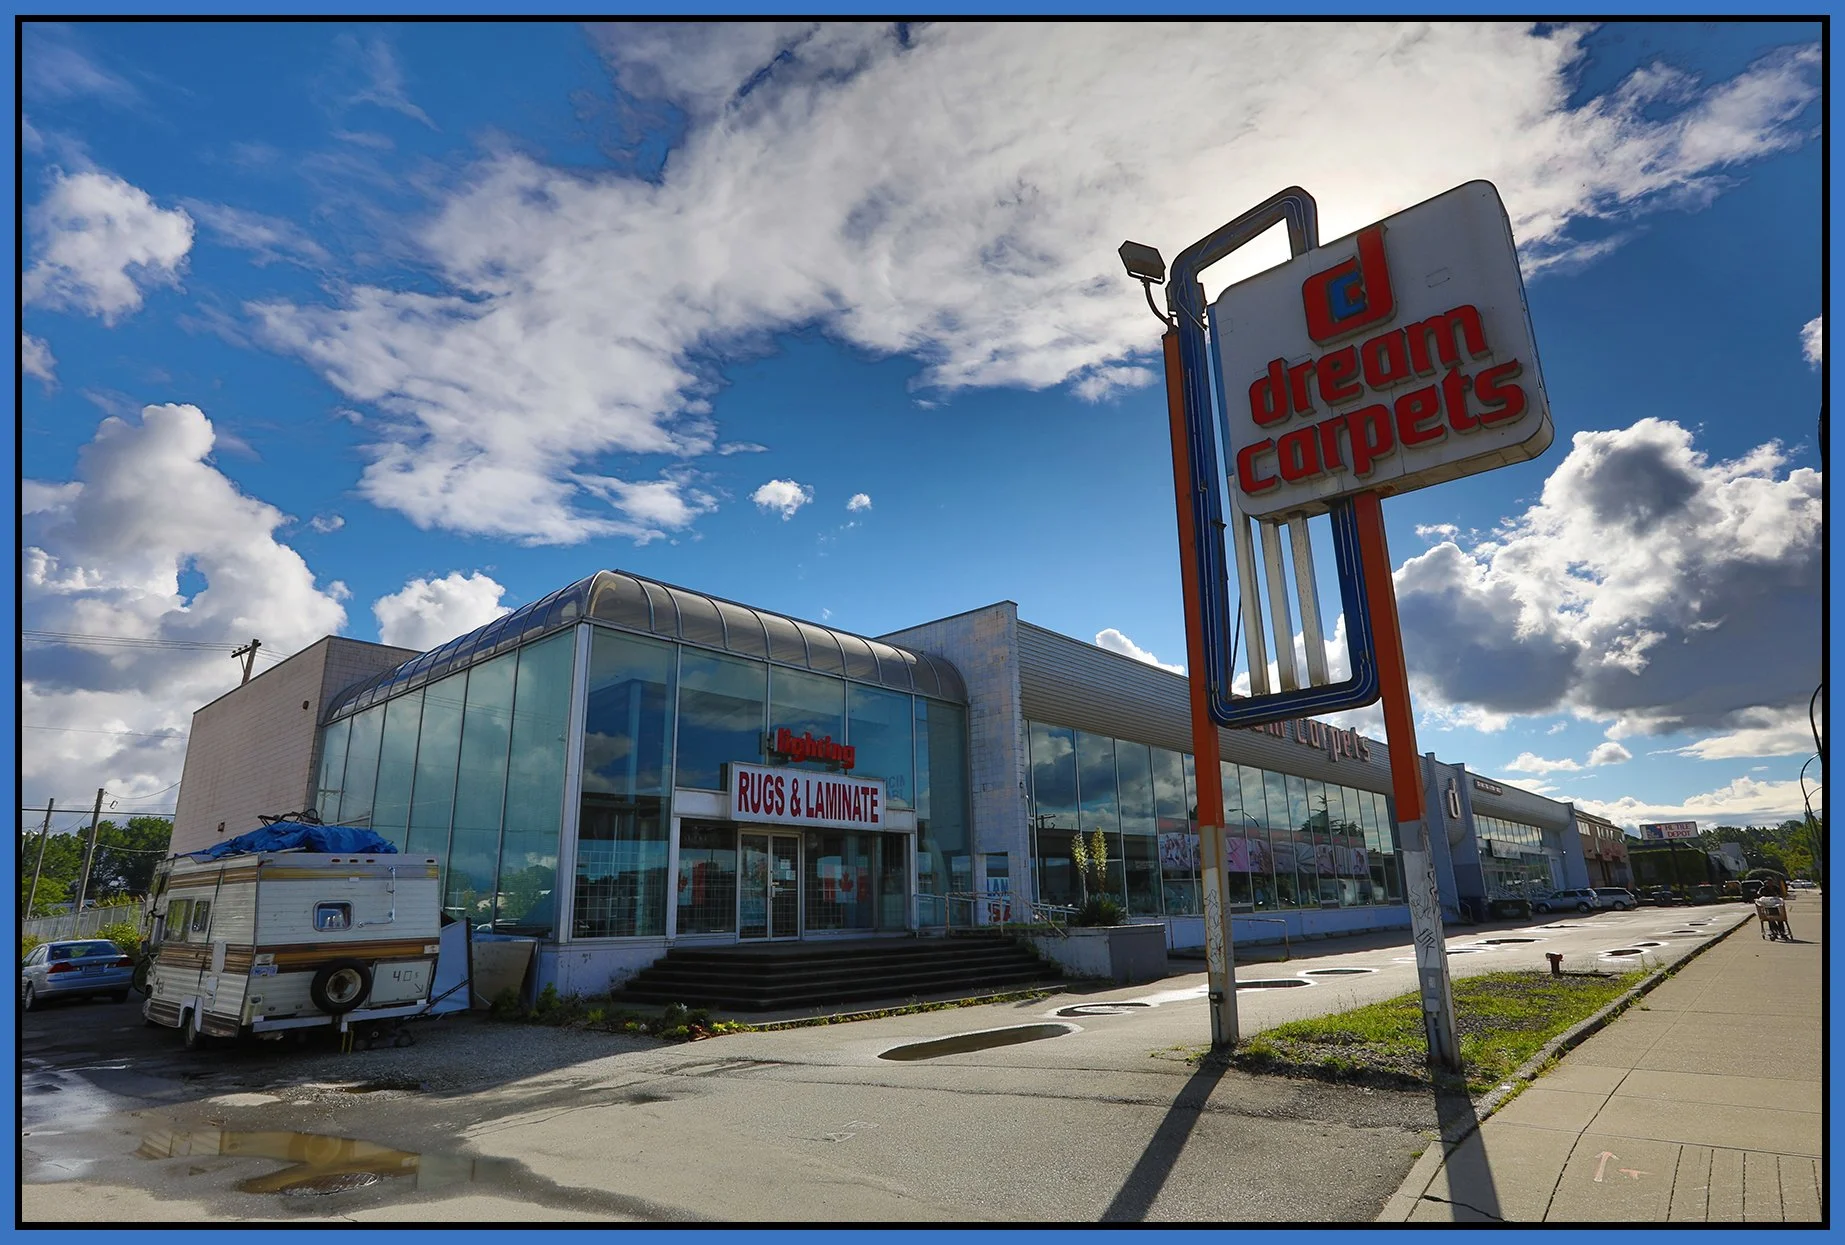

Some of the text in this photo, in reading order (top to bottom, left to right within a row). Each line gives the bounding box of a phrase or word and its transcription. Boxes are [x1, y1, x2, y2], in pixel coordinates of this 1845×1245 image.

[1249, 304, 1491, 427] dream
[1236, 359, 1528, 494] carpets
[776, 728, 856, 769] lighting
[1295, 718, 1371, 762] carpets
[738, 771, 879, 823] RUGS & LAMINATE
